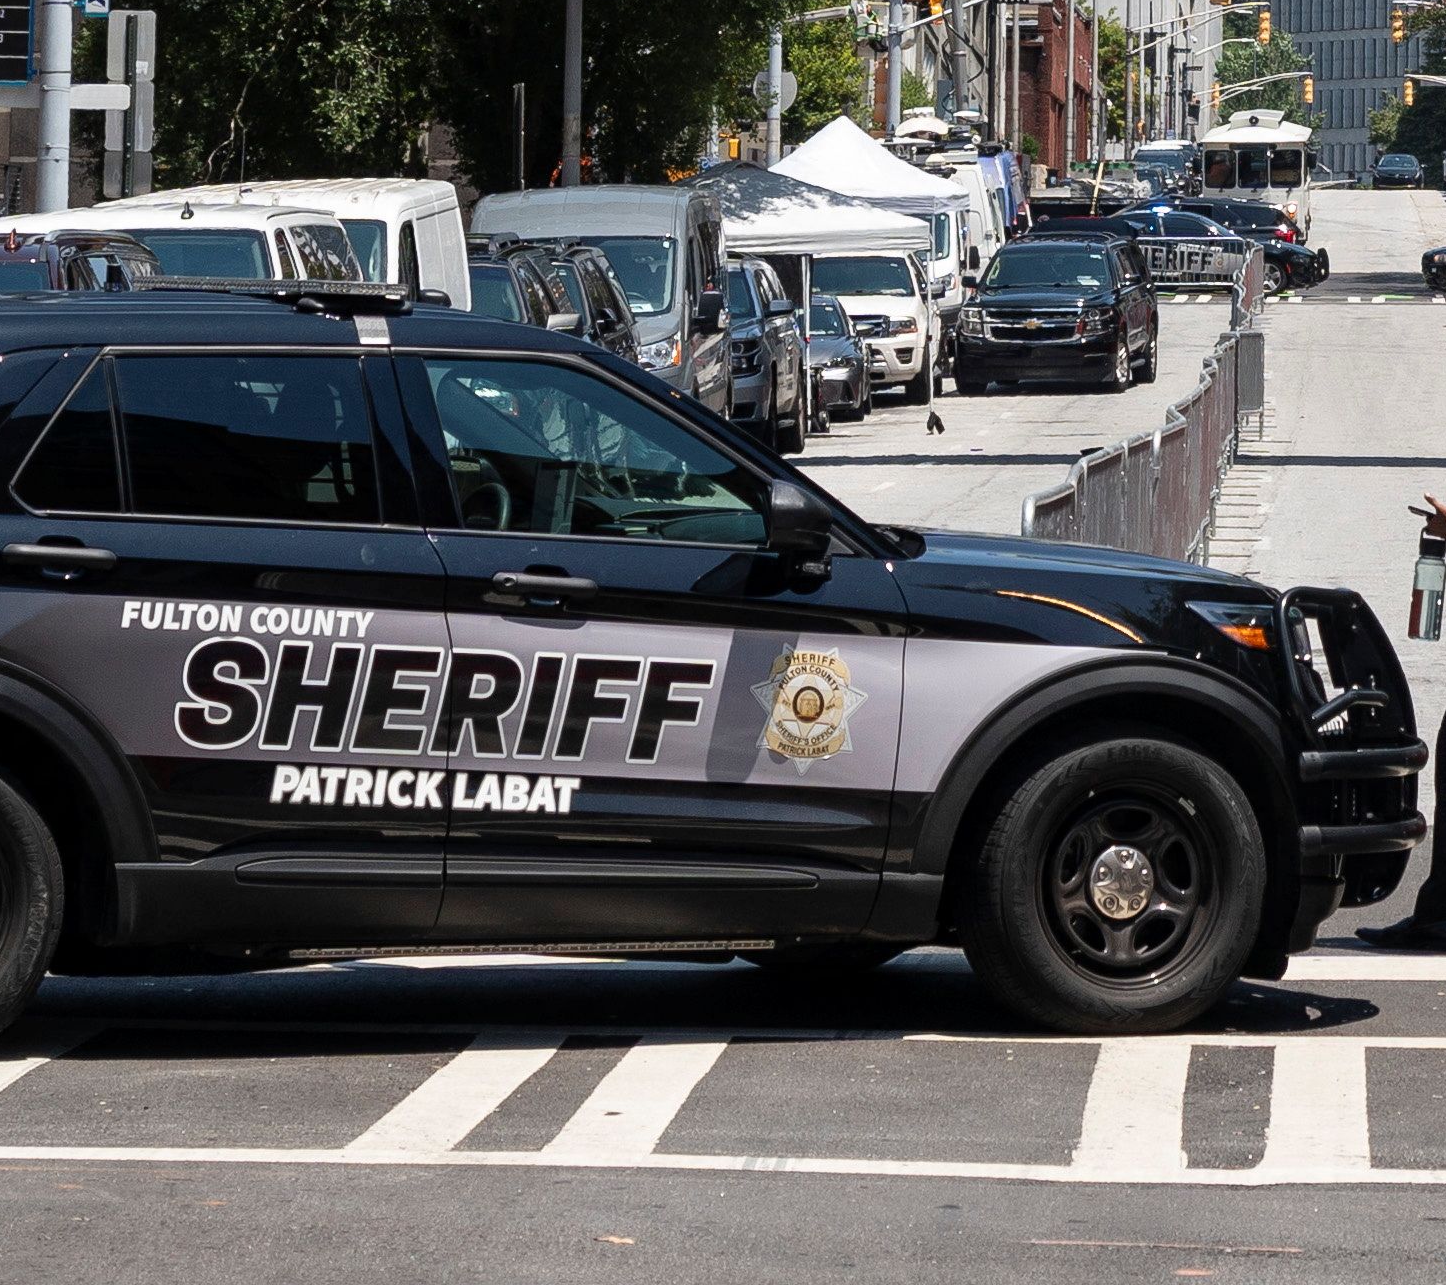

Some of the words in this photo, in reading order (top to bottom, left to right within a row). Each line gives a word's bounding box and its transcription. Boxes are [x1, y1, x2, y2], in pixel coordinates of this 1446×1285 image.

[121, 601, 242, 634] FULTON
[250, 604, 374, 639] COUNTY
[784, 652, 836, 666] SHERIFF
[778, 665, 808, 690] FULTON
[809, 665, 840, 691] COUNTY
[175, 635, 717, 765] SHERIFF
[775, 720, 810, 745] SHERIFF'S
[810, 724, 838, 745] OFFICE
[777, 742, 806, 755] PATRICK
[807, 745, 830, 756] LABAT
[270, 765, 445, 810] PATRICK
[453, 771, 581, 815] LABAT
